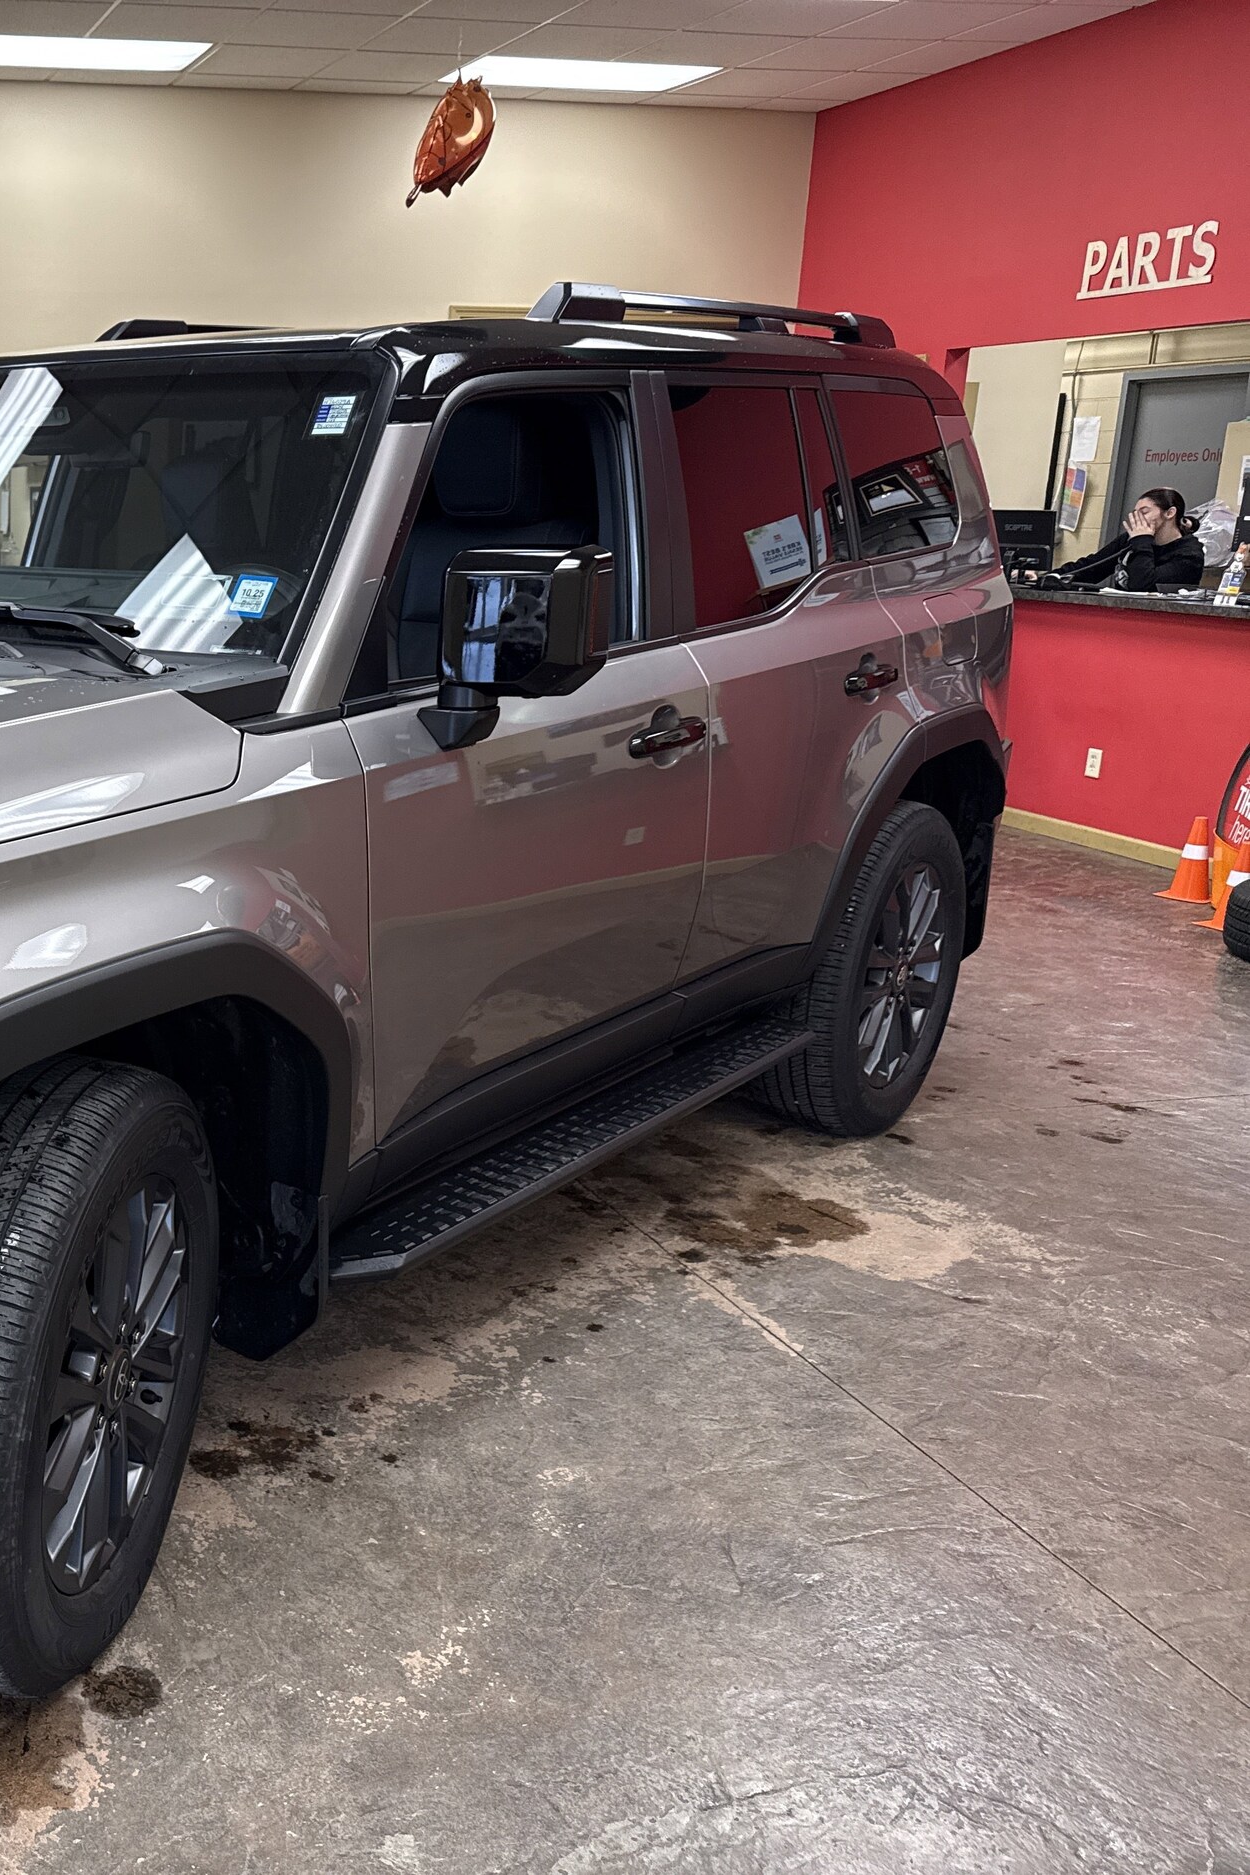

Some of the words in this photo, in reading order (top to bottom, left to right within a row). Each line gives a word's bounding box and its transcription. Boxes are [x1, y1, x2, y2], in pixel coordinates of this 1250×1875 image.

[1076, 220, 1219, 299] PARTS
[1145, 449, 1199, 466] Employees
[1234, 785, 1250, 820] TIR
